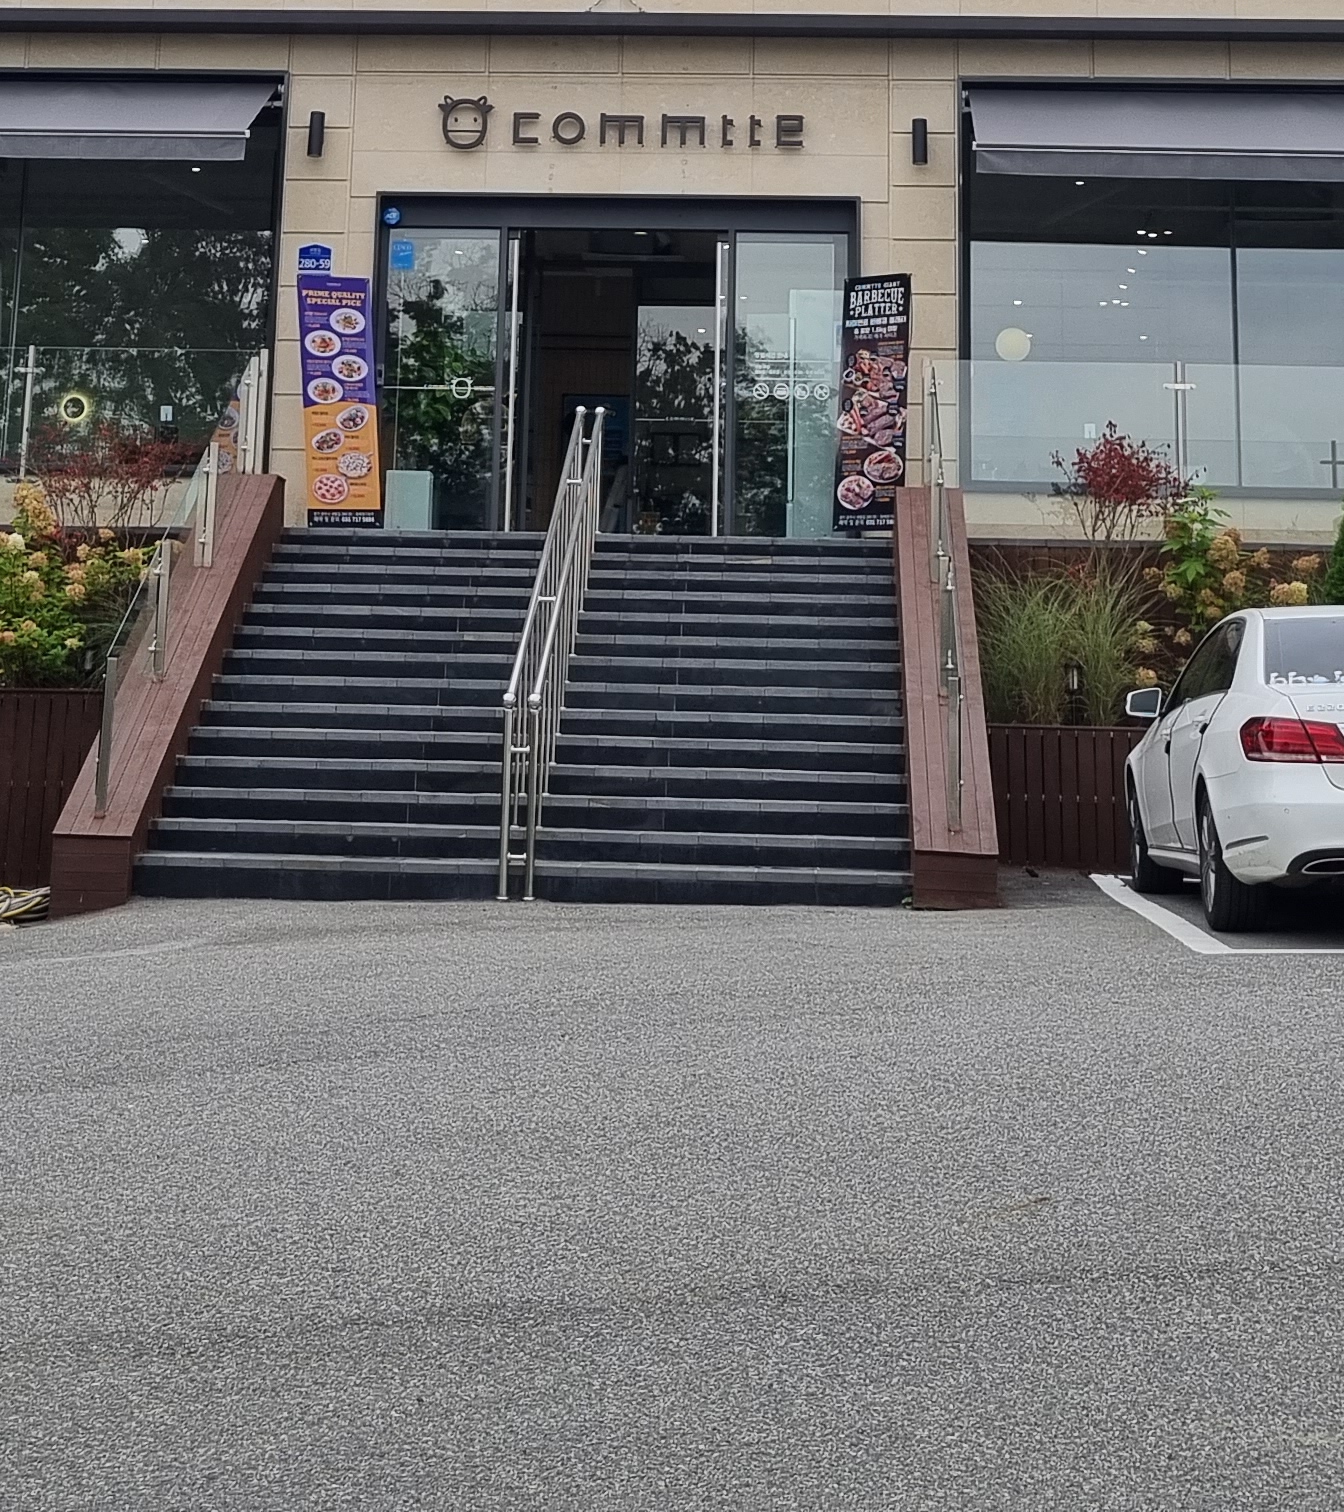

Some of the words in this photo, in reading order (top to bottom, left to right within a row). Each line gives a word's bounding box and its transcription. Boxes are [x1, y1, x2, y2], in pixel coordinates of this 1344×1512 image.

[298, 258, 331, 269] 280-59
[302, 290, 330, 298] PRIME
[331, 291, 366, 300] QUALITY
[849, 288, 905, 309] BARBECUE
[306, 298, 341, 306] SPECIAL
[855, 303, 898, 318] PLATTER
